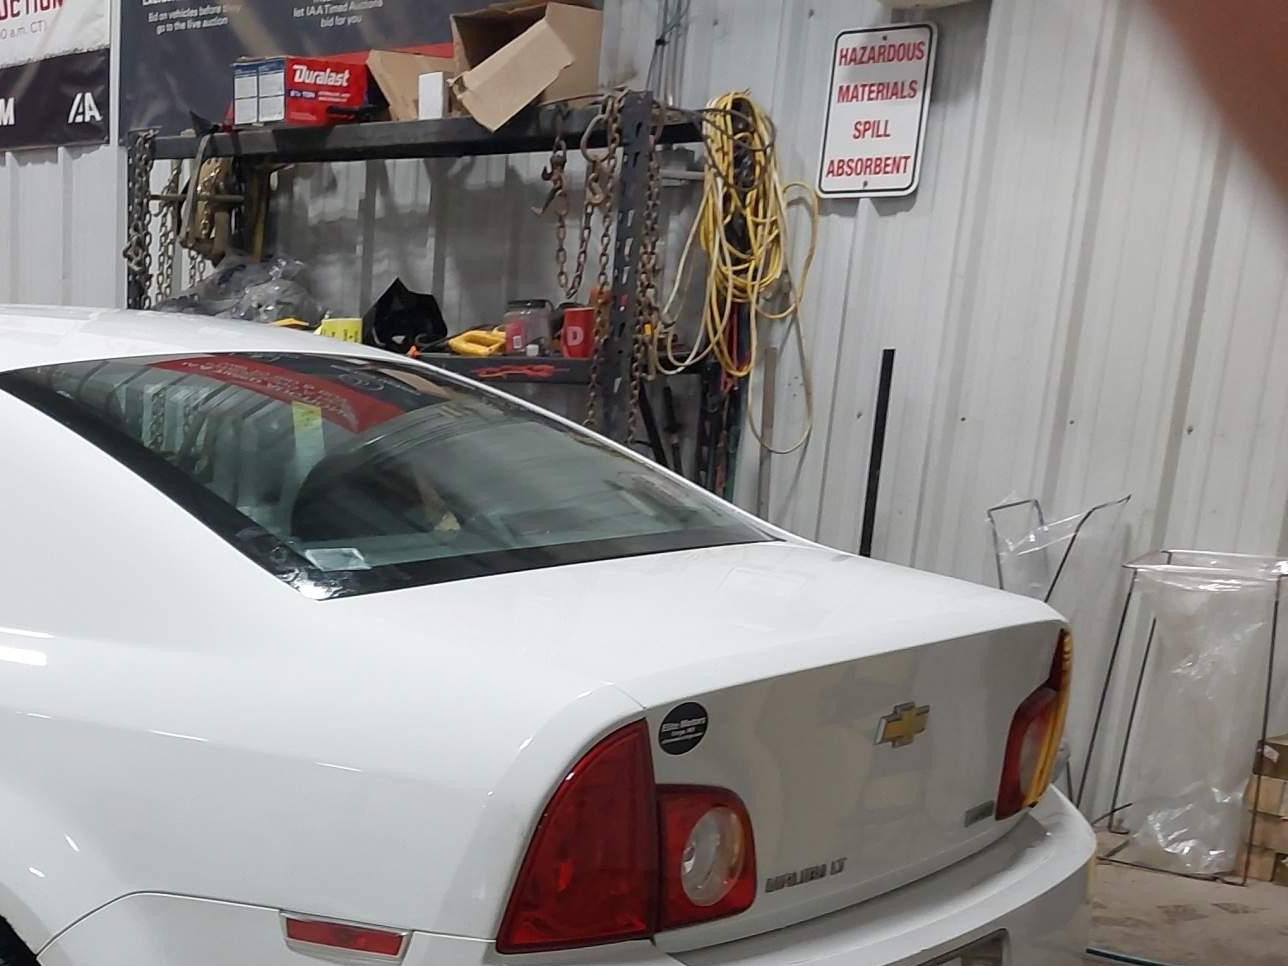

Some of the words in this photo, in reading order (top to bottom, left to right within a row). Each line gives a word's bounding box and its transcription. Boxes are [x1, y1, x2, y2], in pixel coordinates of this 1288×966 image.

[838, 40, 926, 66] HAZARDOUS
[292, 64, 351, 87] Duralast
[837, 79, 918, 104] MATERIALS
[852, 119, 891, 139] SPILL
[825, 155, 911, 178] ABSORBENT
